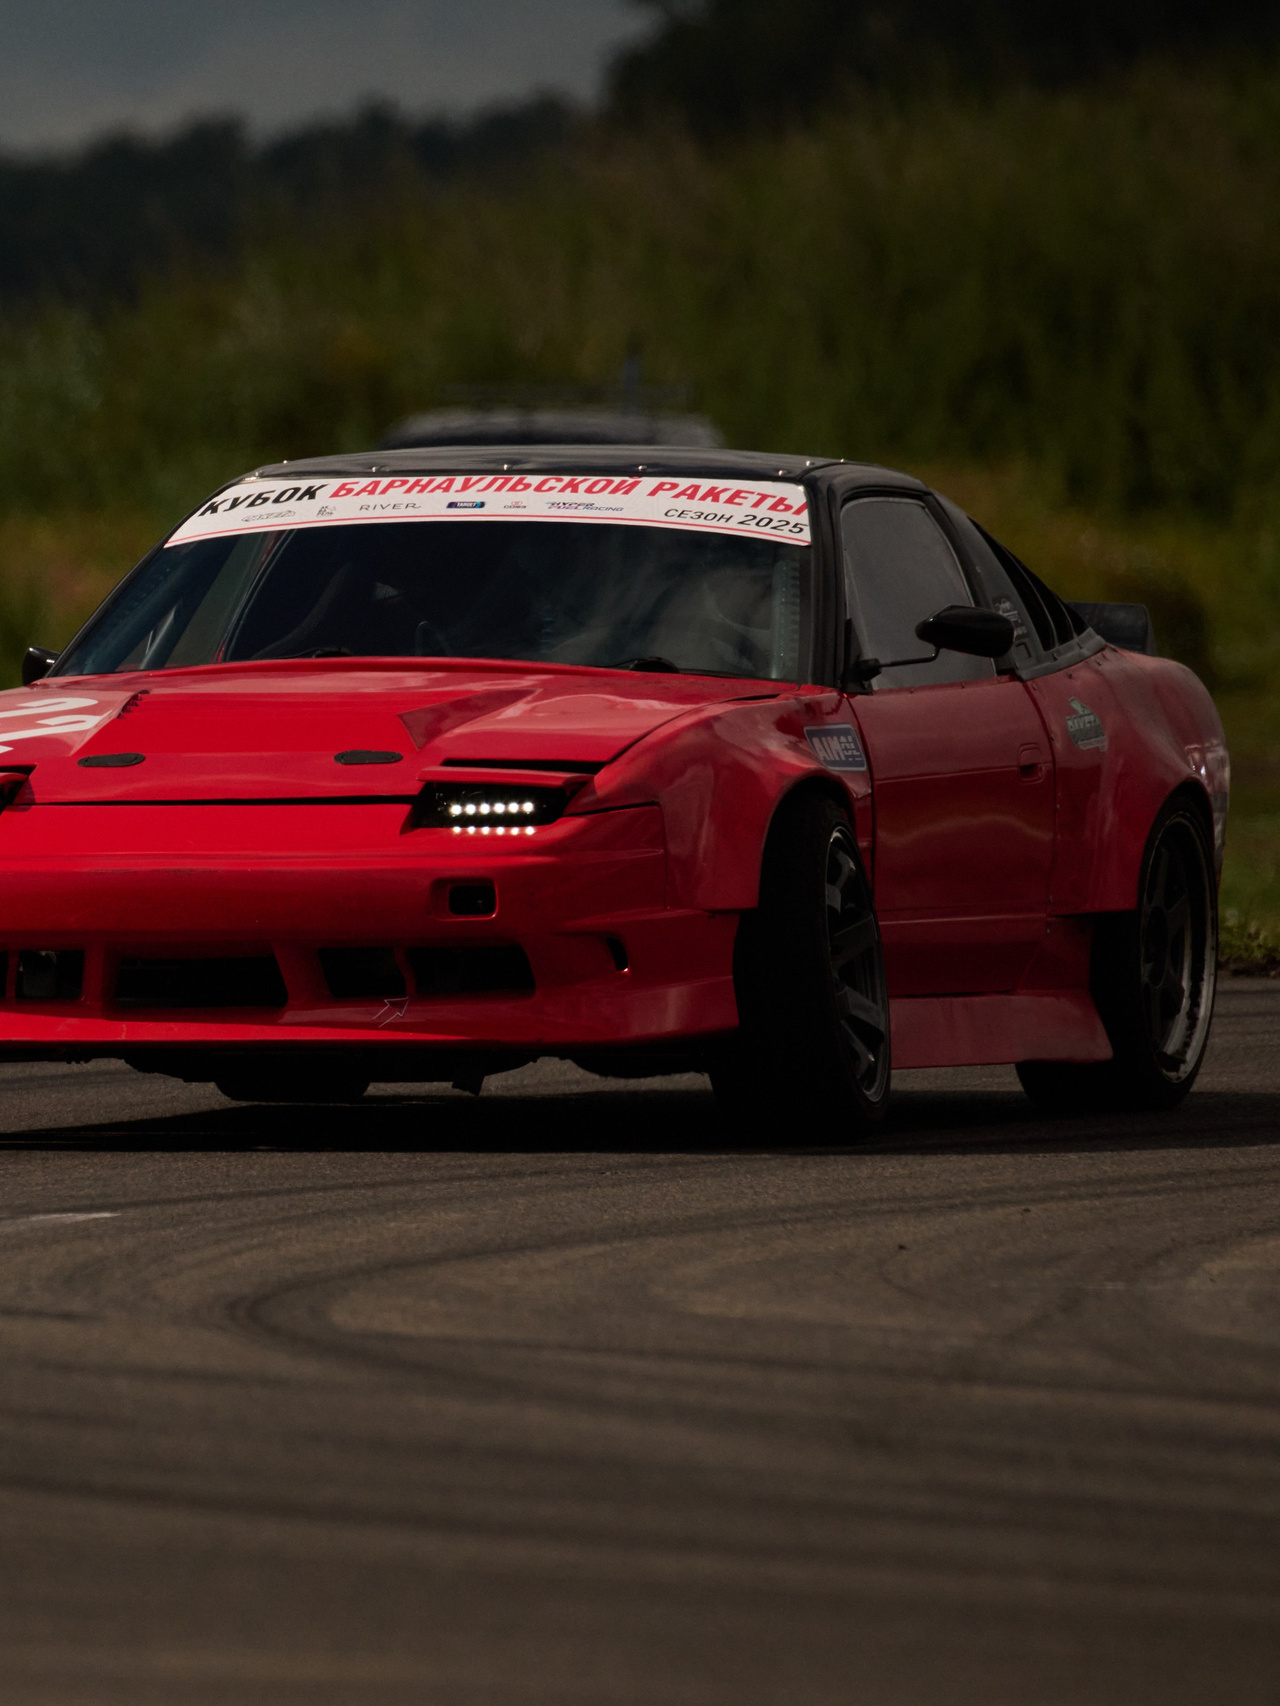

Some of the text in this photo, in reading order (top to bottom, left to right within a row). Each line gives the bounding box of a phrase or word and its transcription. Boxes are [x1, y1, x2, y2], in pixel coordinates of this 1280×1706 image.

[198, 476, 808, 516] КУБОК БАРНАУЛЬСКОЙ РАКЕТЫ
[359, 503, 422, 511] RIVER
[664, 508, 808, 534] СЕЗОН 2025
